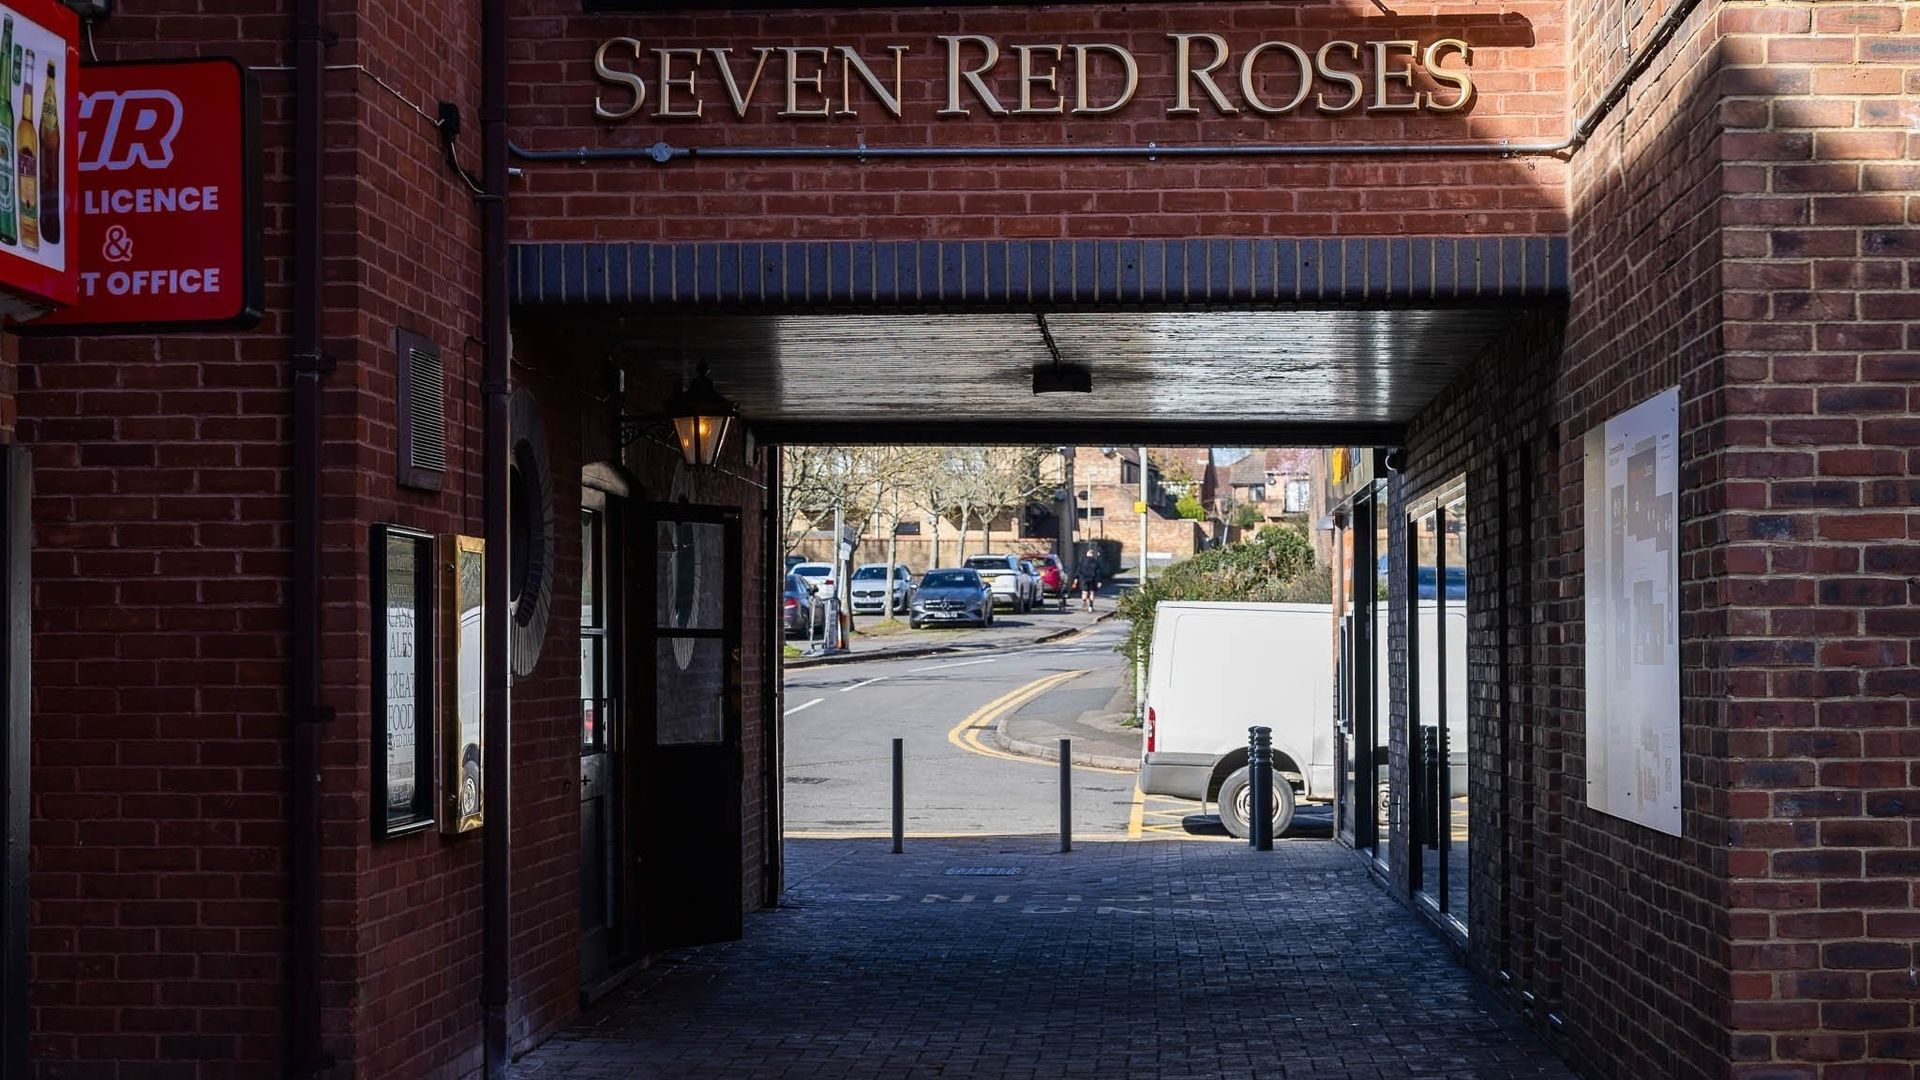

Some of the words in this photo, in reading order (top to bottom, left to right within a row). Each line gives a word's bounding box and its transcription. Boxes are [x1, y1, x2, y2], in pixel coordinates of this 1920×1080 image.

[593, 36, 909, 120] SEVEN
[937, 34, 1139, 117] RED
[1167, 32, 1473, 115] ROSES
[85, 186, 219, 214] LICENCE
[102, 225, 133, 262] &
[106, 268, 220, 295] OFFICE
[389, 631, 413, 658] ALES
[388, 704, 414, 732] FOOD
